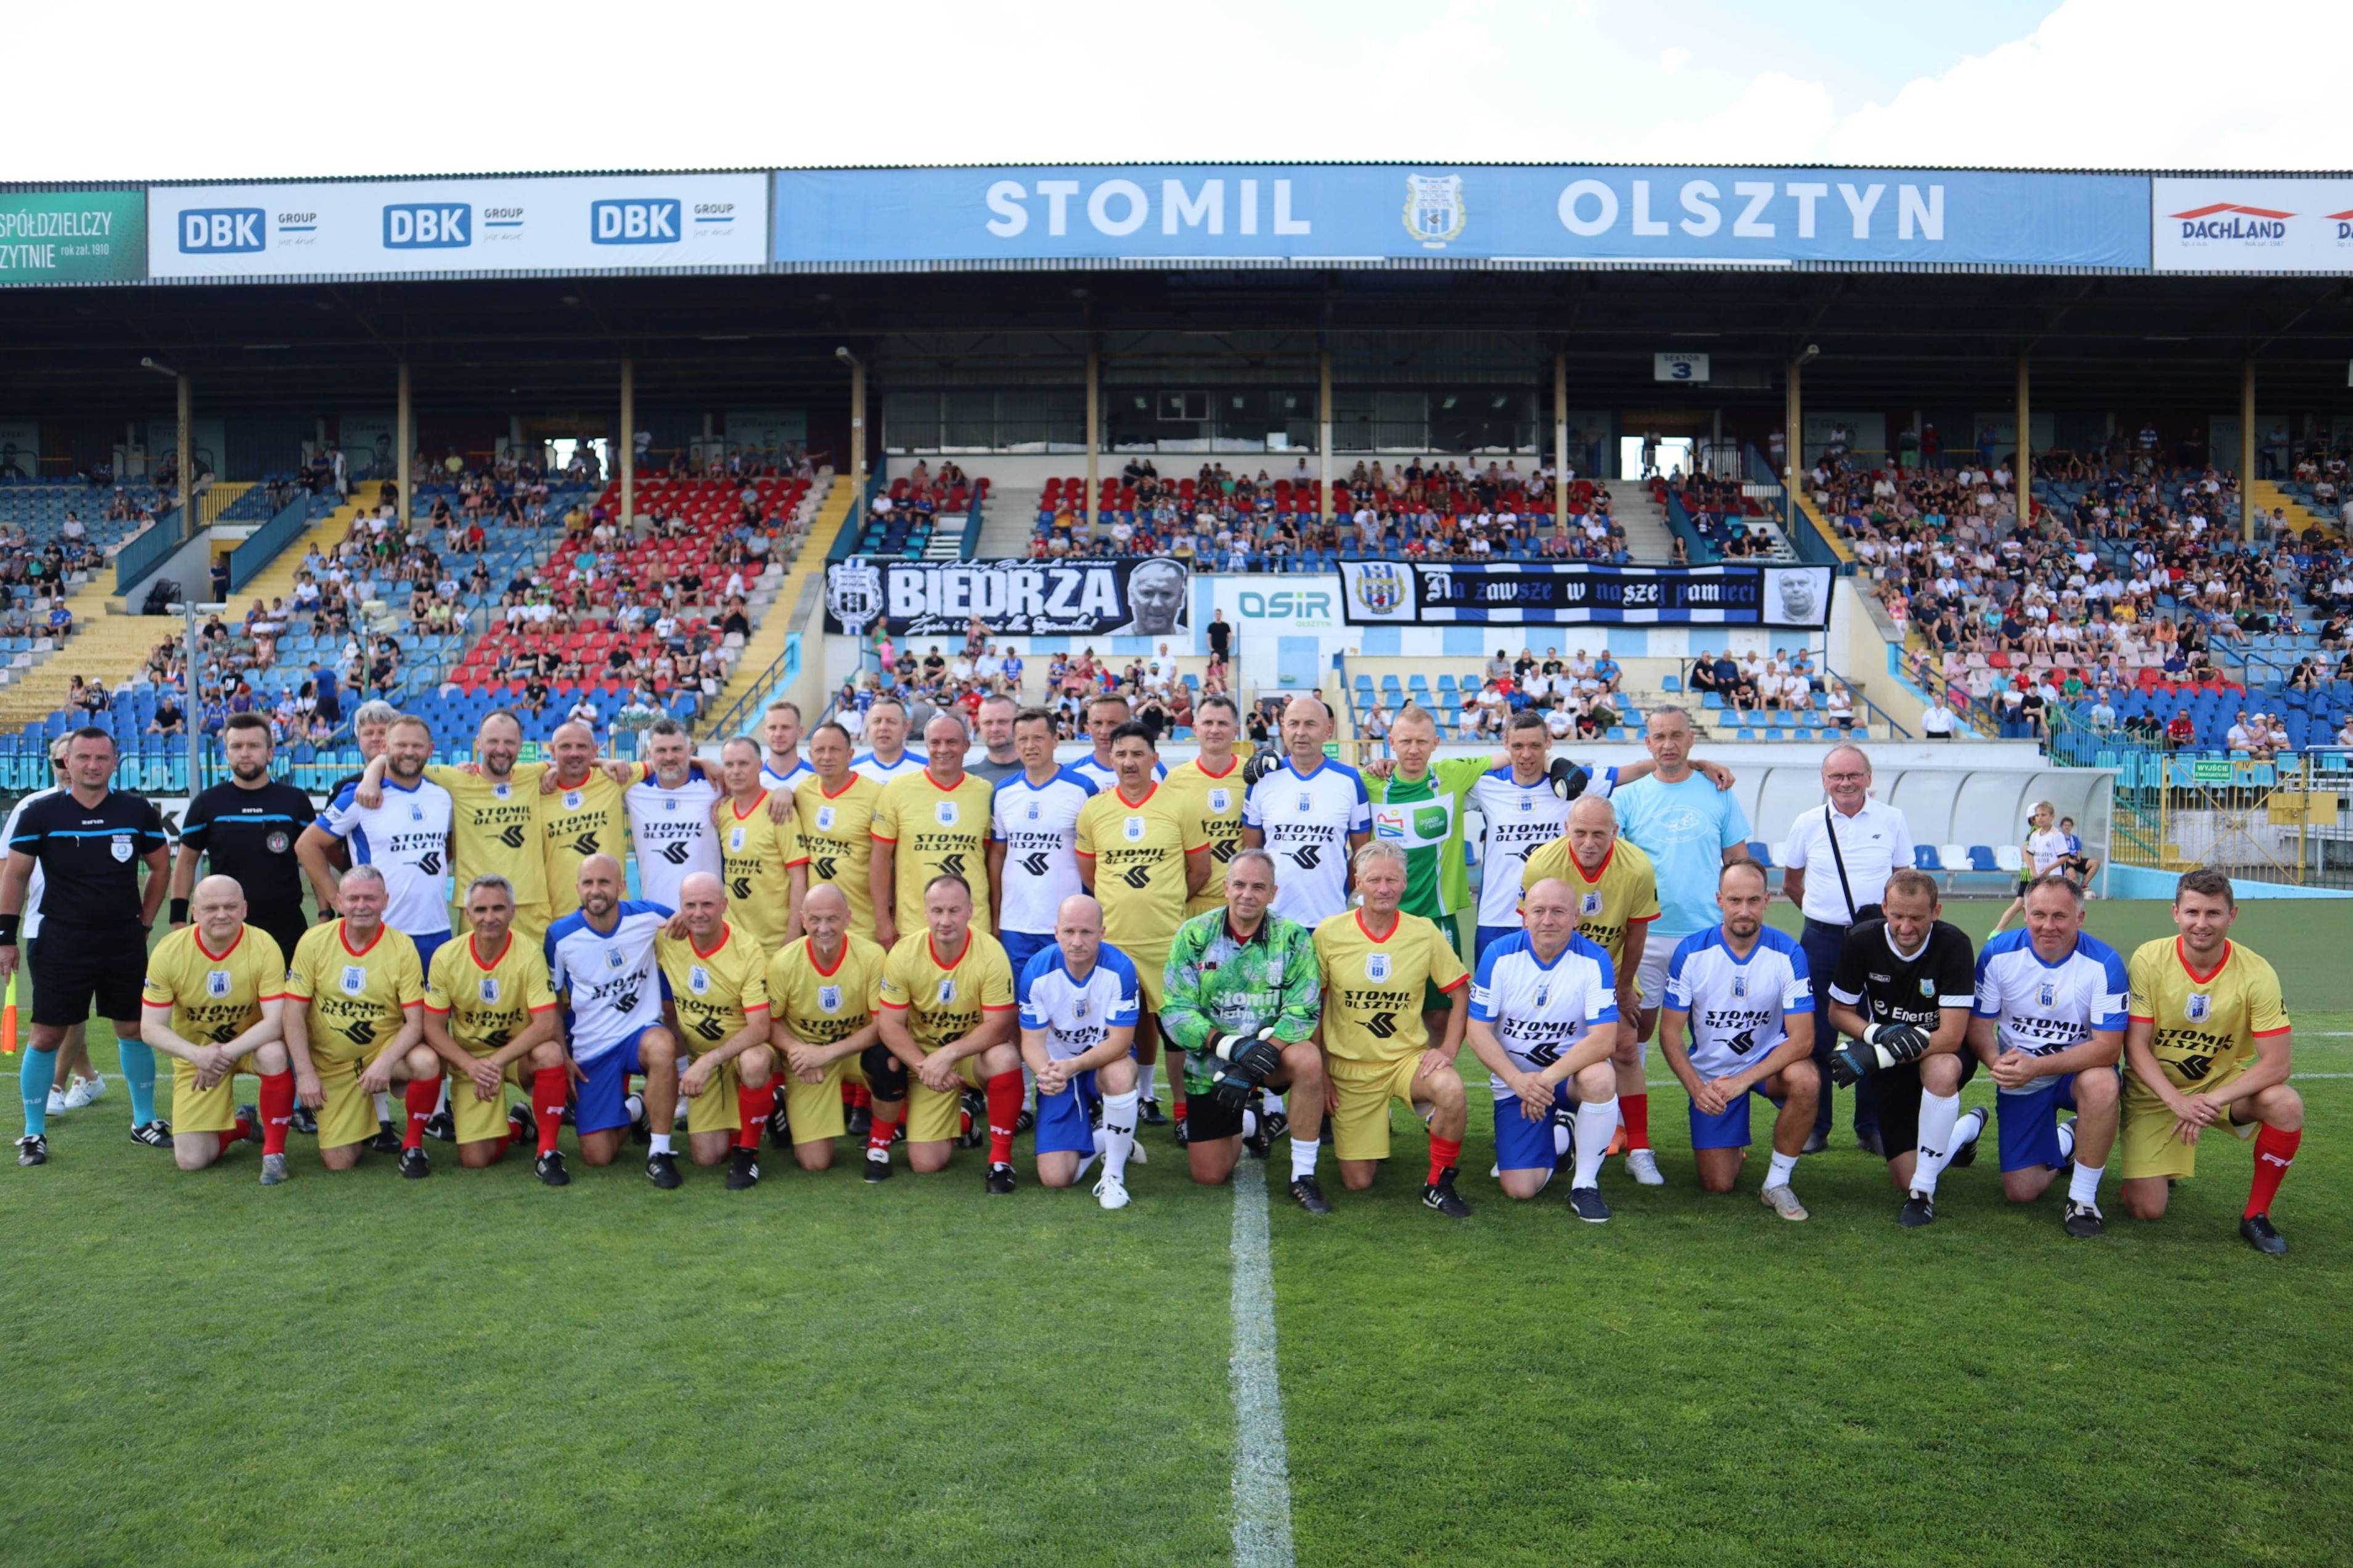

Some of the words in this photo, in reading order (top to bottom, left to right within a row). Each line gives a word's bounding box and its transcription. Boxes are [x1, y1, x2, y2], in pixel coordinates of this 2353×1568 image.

[485, 208, 523, 219] GROUP
[694, 203, 734, 214] GROUP
[986, 179, 1311, 238] STOMIL
[1558, 179, 1944, 240] OLSZTYN
[278, 213, 317, 223] GROUP
[599, 204, 674, 239] DBK
[186, 214, 260, 247] DBK
[390, 209, 465, 243] DBK
[2182, 218, 2285, 239] DACHLAND
[61, 245, 75, 256] rok
[92, 244, 109, 256] 1910
[1672, 362, 1692, 379] 3
[888, 569, 1120, 616] BIEDRZA
[1474, 581, 1553, 604] zawsze
[1566, 582, 1586, 600] w
[1596, 578, 1667, 606] naszej
[475, 805, 531, 817] STOMIL
[473, 814, 531, 825] OLSZTYN
[547, 810, 608, 830] STOMIL
[548, 820, 607, 838] OLSZTYN
[644, 822, 703, 831] STOMIL
[1274, 824, 1335, 835] STOMIL
[1497, 822, 1561, 833] STOMIL
[644, 831, 702, 839] OLSZTYN
[914, 833, 977, 844] STOMIL
[1009, 832, 1063, 842] STOMIL
[1274, 833, 1334, 843] OLSZTYN
[1496, 832, 1561, 842] OLSZTYN
[914, 843, 976, 851] OLSZTYN
[1105, 847, 1165, 857] STOMIL
[1105, 855, 1164, 864] OLSZTYN
[1345, 990, 1410, 1002] STOMIL
[1345, 1000, 1409, 1010] OLSZTYN
[465, 1008, 523, 1020] STOMIL
[1706, 1011, 1771, 1020] STOMIL
[1892, 1007, 1939, 1023] Energa
[1505, 1018, 1578, 1032] STOMIL
[1705, 1019, 1770, 1029] OLSZTYN
[2012, 1016, 2087, 1033] STOMIL
[1504, 1027, 1576, 1040] OLSZTYN
[2012, 1024, 2089, 1042] OLSZTYN
[2158, 1028, 2235, 1043] STOMIL
[2155, 1037, 2233, 1054] OLSZTYN
